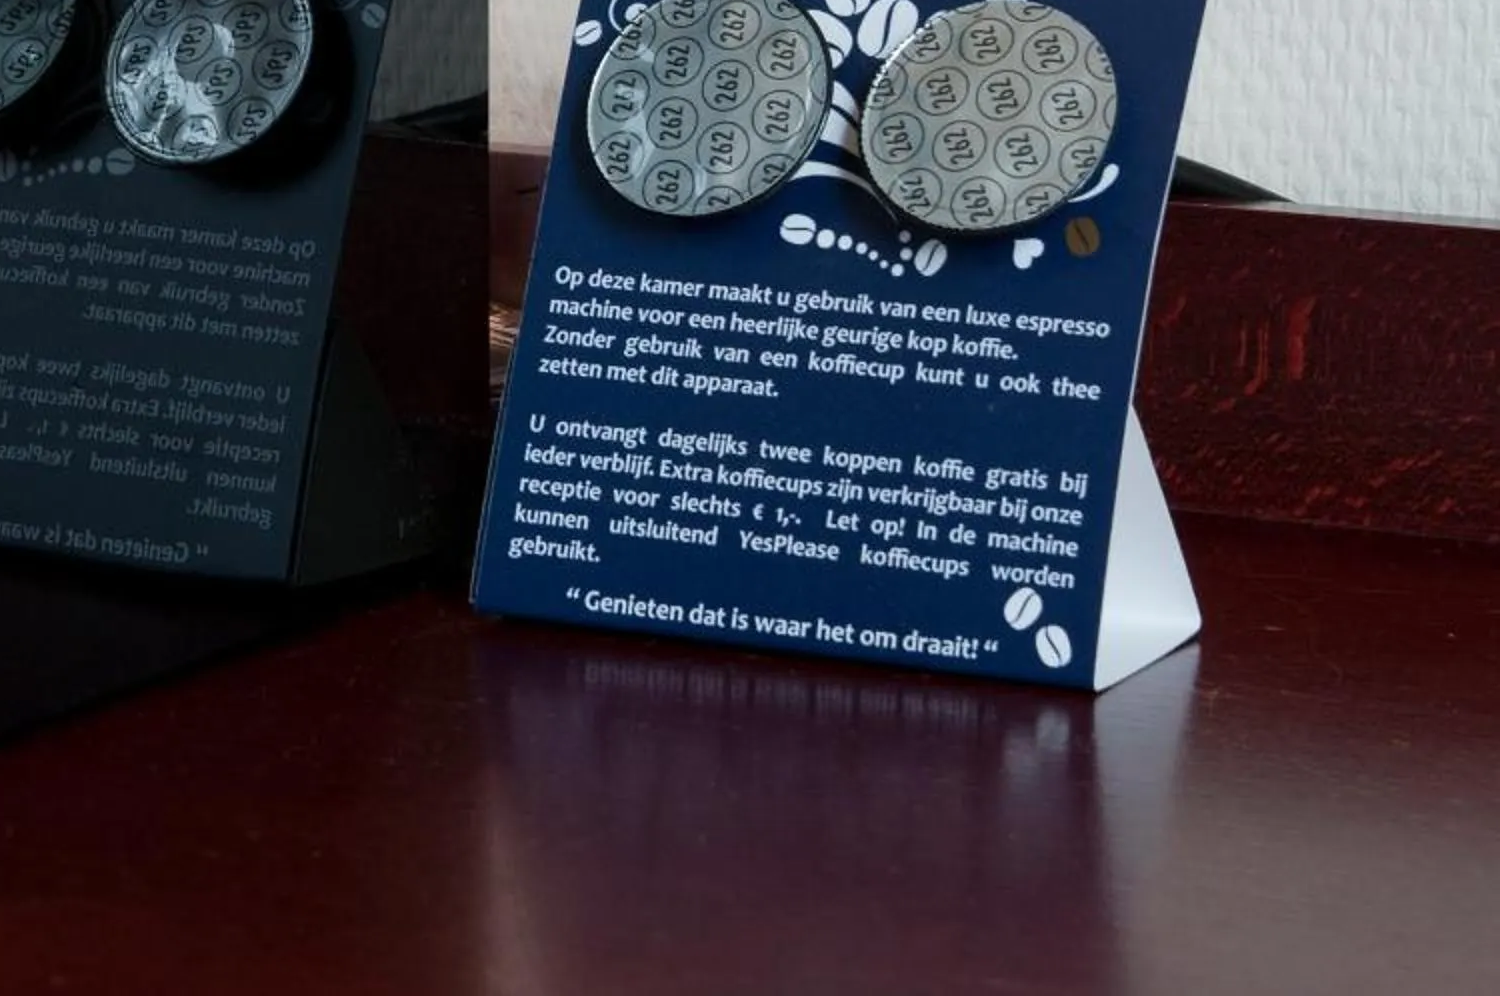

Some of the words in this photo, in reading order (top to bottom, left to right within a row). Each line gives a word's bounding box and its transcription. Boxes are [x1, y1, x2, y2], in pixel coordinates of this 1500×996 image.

[720, 8, 747, 43] 262
[970, 25, 1001, 60] 262
[665, 44, 690, 82] 262
[771, 36, 796, 72] 262
[1033, 34, 1065, 69] 262
[715, 67, 739, 104] 262
[926, 74, 957, 109] 262
[987, 77, 1019, 115] 262
[660, 105, 683, 141] 262
[766, 99, 791, 136] 262
[1051, 87, 1084, 125] 262
[607, 139, 631, 175] 262
[709, 130, 734, 168] 262
[882, 120, 913, 157] 262
[943, 127, 974, 165] 262
[1005, 132, 1038, 172] 262
[656, 169, 680, 205] 262
[900, 175, 931, 213] 262
[961, 184, 994, 223] 262
[553, 264, 585, 291] Op
[586, 266, 636, 292] deze
[638, 271, 705, 298] kamer
[706, 282, 773, 305] maakt
[775, 290, 791, 307] u
[792, 288, 875, 315] gebruik
[878, 300, 918, 319] van
[920, 303, 962, 323] een
[964, 302, 1012, 329] luxe
[1014, 313, 1112, 339] espresso
[547, 296, 634, 322] machine
[636, 306, 686, 327] voor
[686, 312, 727, 331] een
[728, 310, 820, 342] heerlijke
[820, 324, 904, 352] geurige
[905, 328, 949, 357] kop
[950, 332, 1019, 361] koffie.
[536, 356, 603, 379] zetten
[604, 364, 648, 384] met
[649, 364, 680, 388] dit
[680, 372, 780, 398] apparaat.
[542, 323, 617, 349] Zonder
[622, 333, 703, 359] gebruik
[712, 344, 751, 364] van
[758, 349, 799, 369] een
[806, 349, 906, 385] koffiecup
[914, 360, 965, 387] kunt
[973, 371, 990, 389] u
[998, 371, 1041, 395] ook
[1050, 374, 1102, 401] thee
[528, 412, 547, 434] U
[554, 418, 648, 449] ontvangt
[656, 426, 749, 458] dagelijks
[758, 438, 813, 464] twee
[821, 443, 903, 475] koppen
[912, 453, 976, 482] koffie
[983, 466, 1049, 490] gratis
[1058, 469, 1089, 500] bij
[522, 441, 577, 467] ieder
[578, 451, 655, 479] verblijf.
[658, 458, 714, 483] Extra
[715, 463, 824, 500] koffiecups
[824, 477, 864, 504] zijn
[866, 484, 998, 516] verkrijgbaar
[998, 495, 1029, 524] bij
[1029, 504, 1084, 527] onze
[517, 475, 603, 502] receptie
[611, 487, 661, 508] voor
[669, 490, 742, 518] slechts
[751, 502, 765, 521] €
[824, 508, 861, 532] Let
[868, 516, 907, 541] op!
[915, 518, 938, 541] In
[947, 522, 977, 546] de
[986, 530, 1080, 558] machine
[506, 534, 601, 563] gebruikt.
[512, 500, 590, 531] kunnen
[607, 514, 720, 547] uitsluitend
[738, 528, 841, 562] YesPlease
[858, 542, 971, 581] koffiecups
[990, 563, 1076, 589] worden
[687, 601, 727, 629] dat
[729, 605, 750, 631] is
[752, 614, 813, 638] waar
[814, 616, 856, 645] het
[858, 628, 898, 650] om
